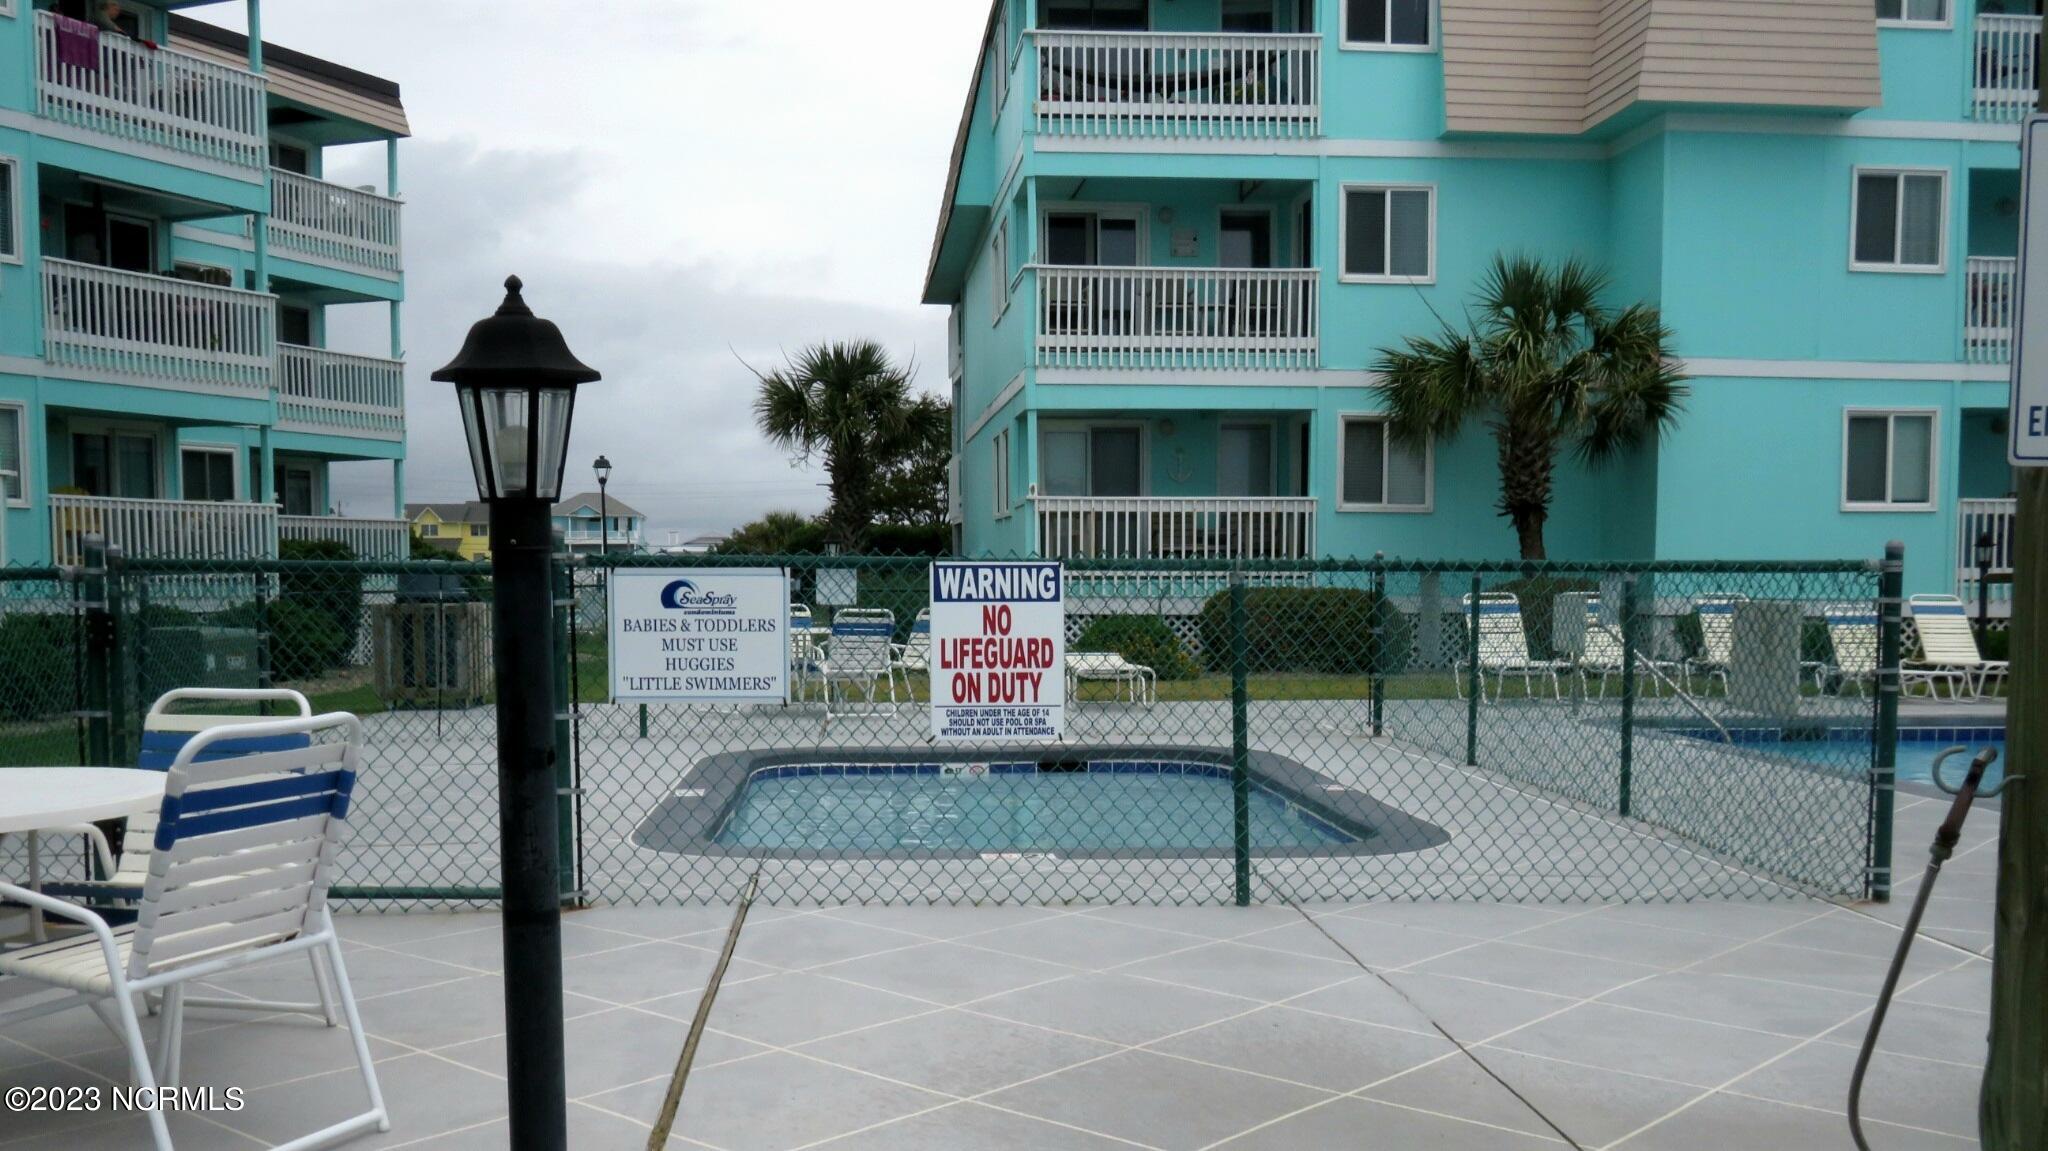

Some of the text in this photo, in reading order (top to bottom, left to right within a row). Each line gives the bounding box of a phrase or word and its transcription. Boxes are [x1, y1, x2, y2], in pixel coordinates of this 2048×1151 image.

[2029, 405, 2048, 437] E
[938, 567, 1056, 600] WARNING
[680, 591, 737, 606] SeaSpray
[623, 618, 776, 632] BABIES & TODDLERS
[982, 604, 1012, 636] NO
[662, 638, 738, 652] MUST USE
[940, 637, 1054, 669] LIFEGUARD
[665, 657, 735, 671] HUGGIES
[623, 676, 777, 691] "LITTLE SWIMMERS"
[952, 671, 1043, 704] ON DUTY
[946, 709, 977, 717] CHILDREN
[980, 709, 1001, 717] UNDER
[949, 718, 1047, 726] SHOULD NOT USE POOL OR SPA
[941, 728, 970, 736] WITHOUT
[1005, 727, 1011, 735] IN
[1013, 727, 1055, 735] ATTENDANCE
